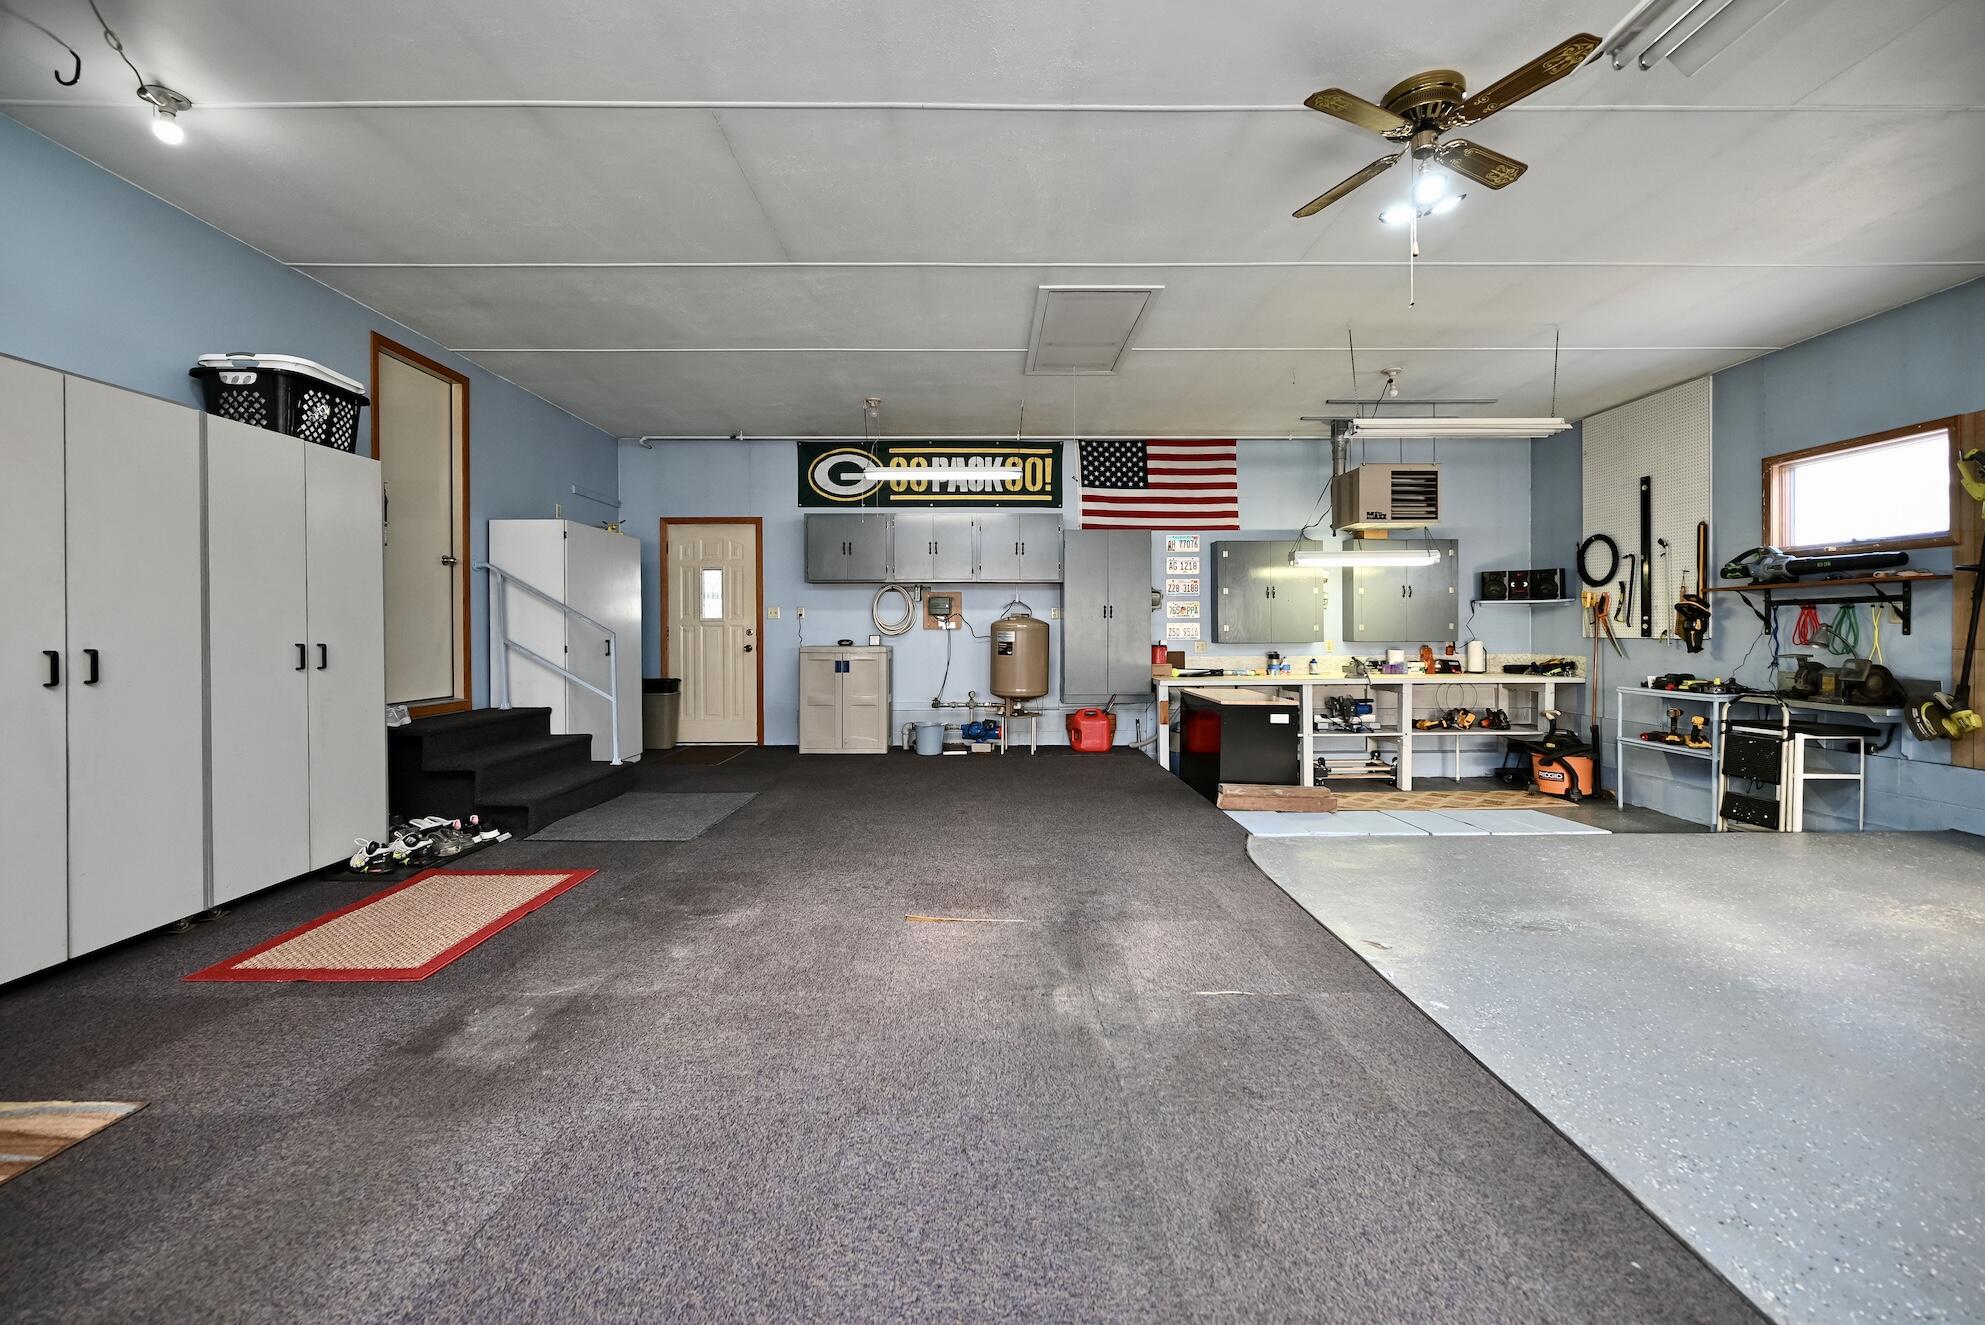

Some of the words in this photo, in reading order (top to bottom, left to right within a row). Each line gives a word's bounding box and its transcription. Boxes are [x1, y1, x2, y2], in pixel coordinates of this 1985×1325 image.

[932, 457, 1004, 492] PACK
[1005, 457, 1053, 492] GO!
[1179, 540, 1199, 549] 77076
[1168, 561, 1178, 571] AG
[1180, 561, 1198, 571] 1218
